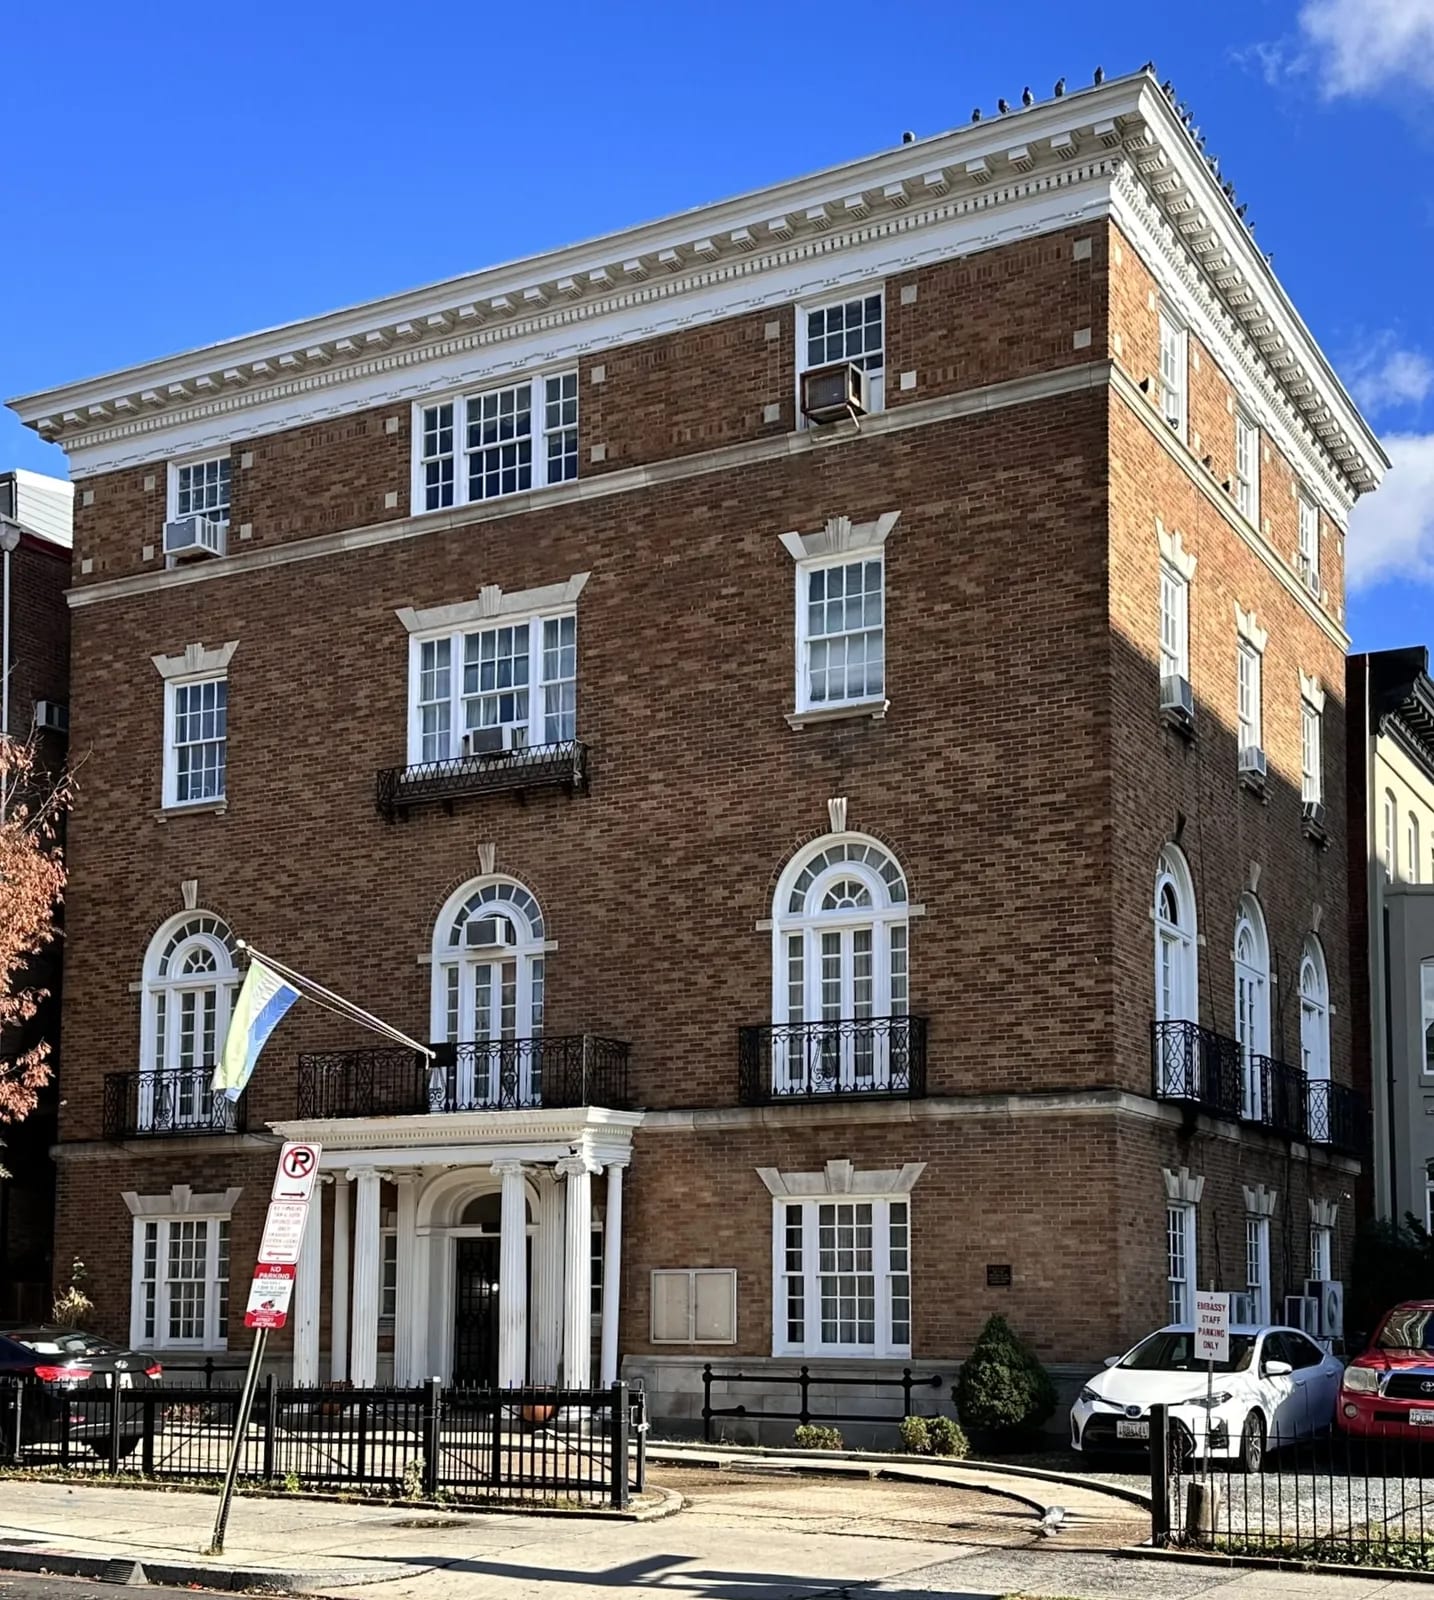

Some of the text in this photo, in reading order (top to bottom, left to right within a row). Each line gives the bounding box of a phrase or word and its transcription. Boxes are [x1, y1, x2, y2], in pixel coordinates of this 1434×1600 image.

[291, 1151, 310, 1173] P
[258, 1272, 290, 1280] PARKING
[1197, 1301, 1226, 1312] EMBASSY
[1201, 1315, 1221, 1324] STAFF
[1198, 1327, 1225, 1338] PARKING
[1203, 1341, 1219, 1350] ONLY
